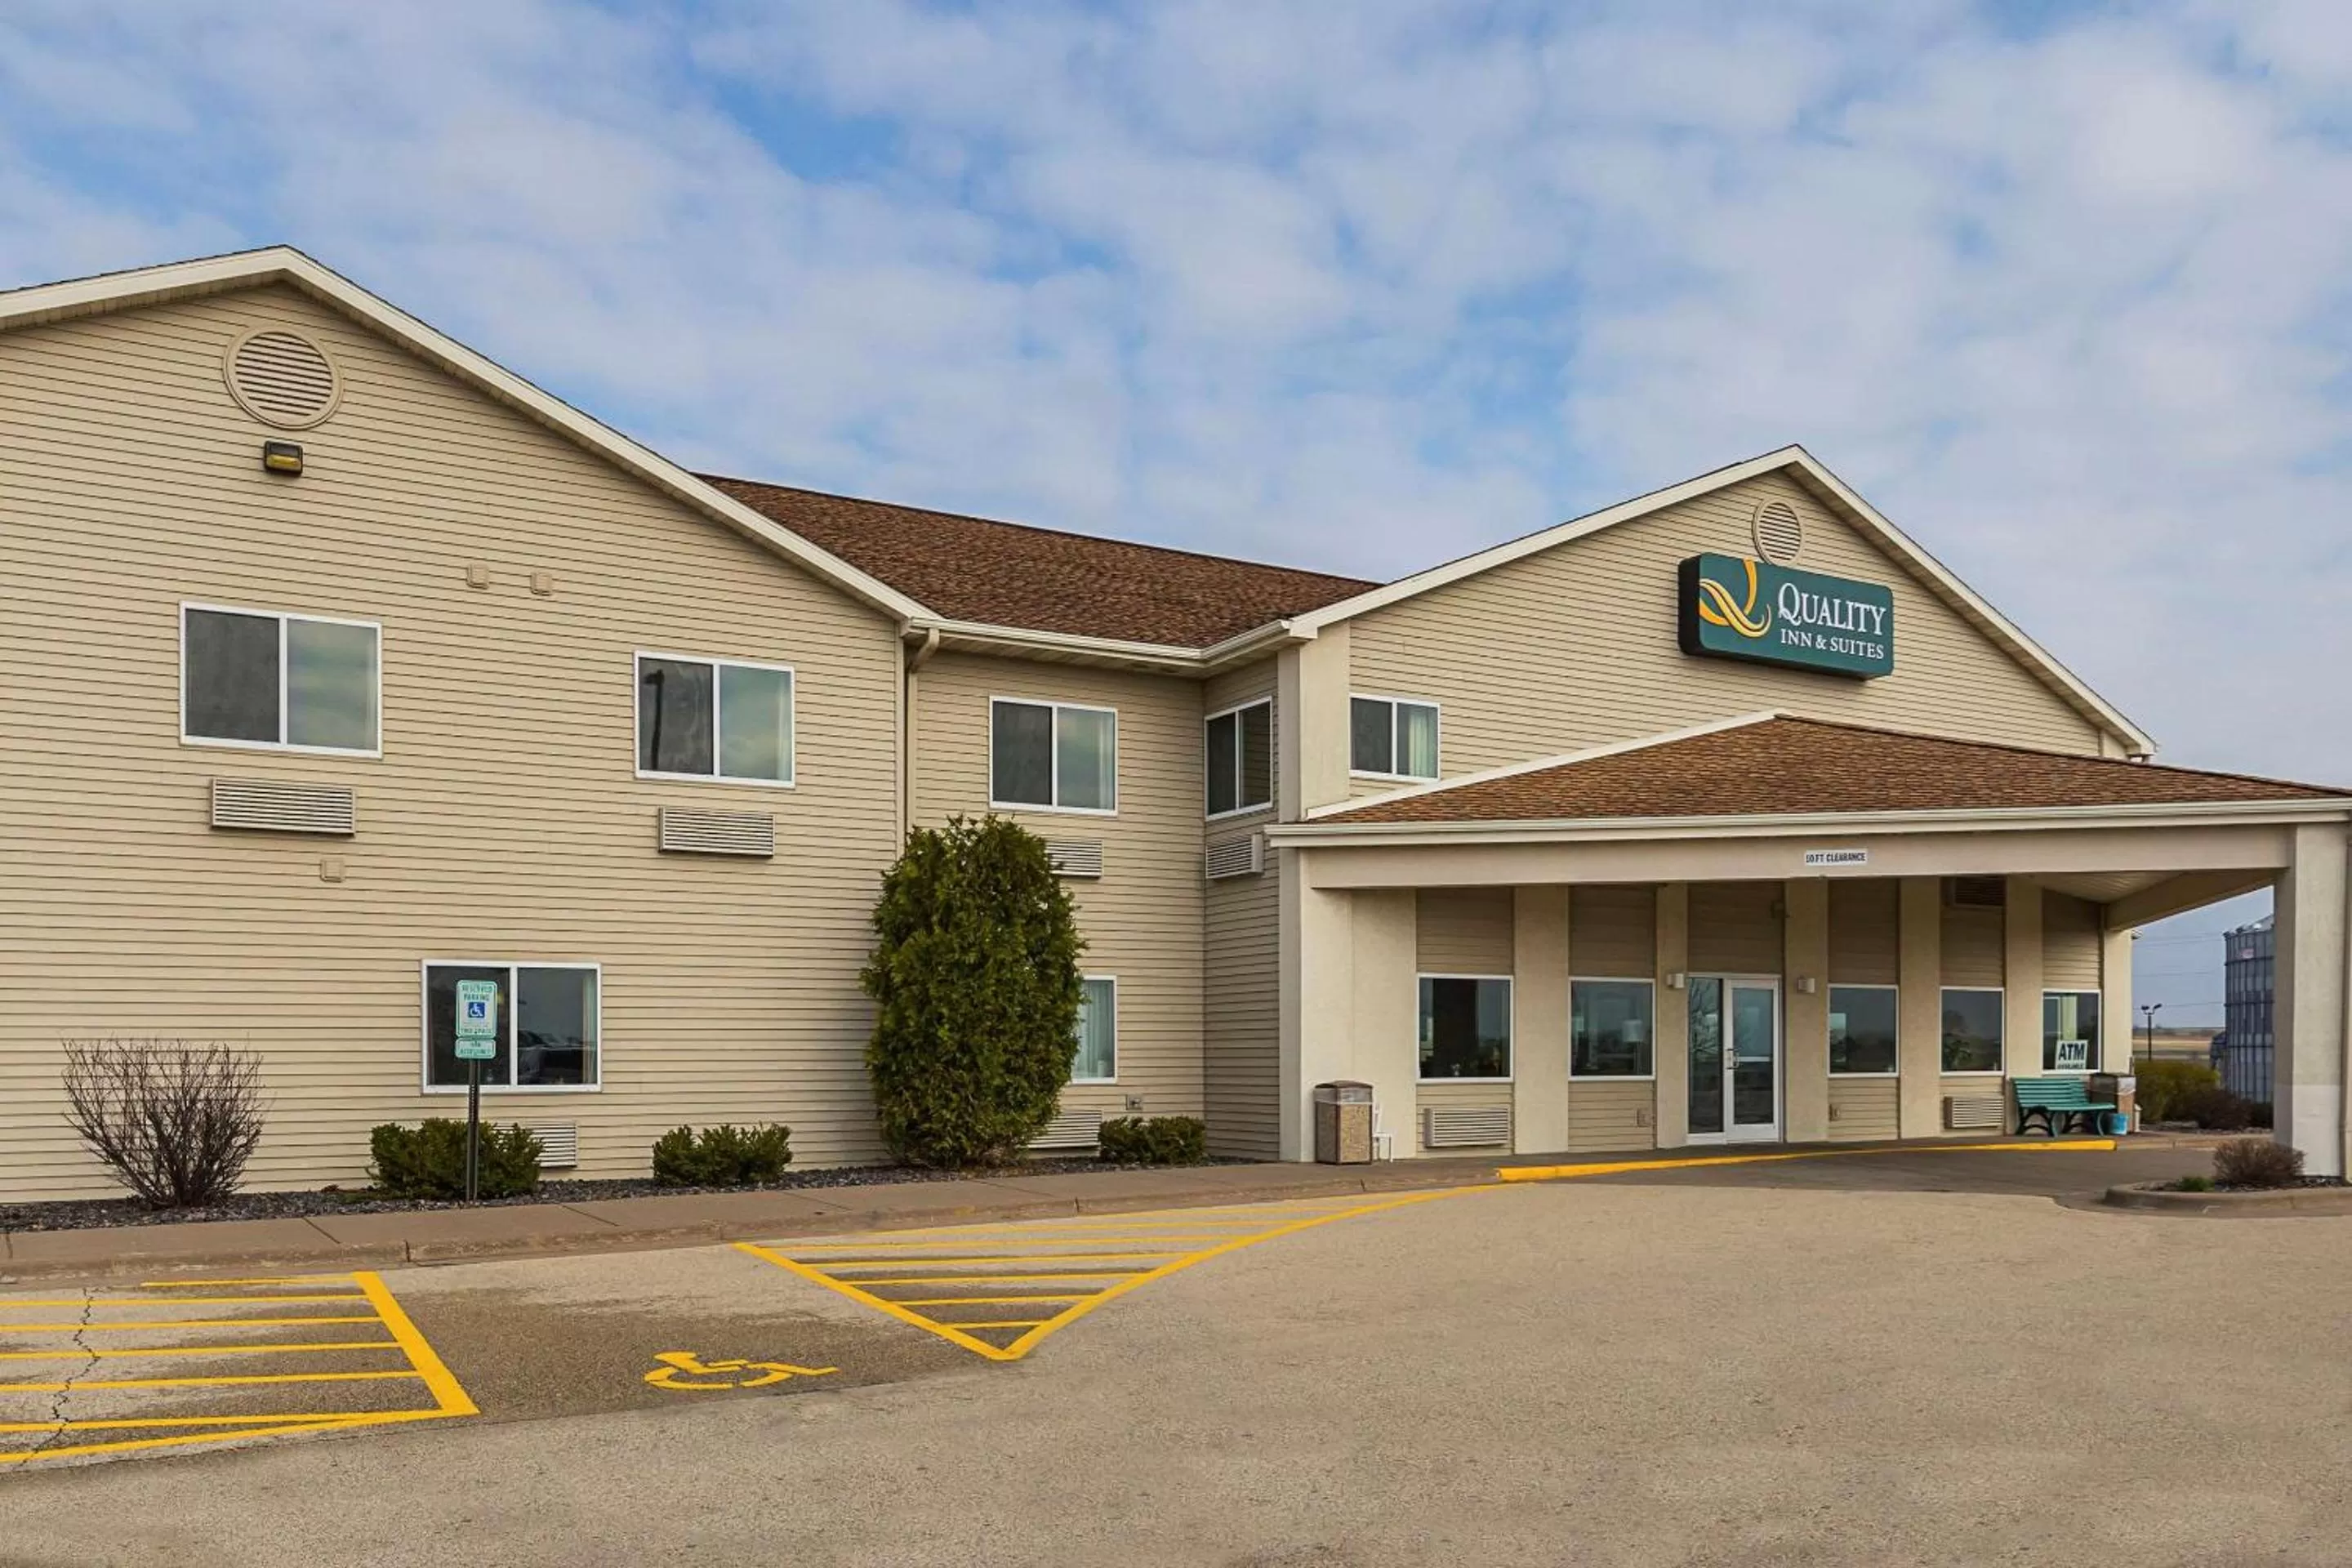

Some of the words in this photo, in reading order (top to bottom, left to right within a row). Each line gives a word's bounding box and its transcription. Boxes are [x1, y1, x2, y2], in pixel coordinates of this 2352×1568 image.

[1778, 582, 1886, 635] QUALITY
[1780, 628, 1812, 648] INN
[1815, 634, 1828, 650] &
[1829, 635, 1884, 660] SUITES
[1815, 853, 1824, 863] FT
[1826, 852, 1866, 863] CLEARANCE
[2058, 1042, 2085, 1061] ATM
